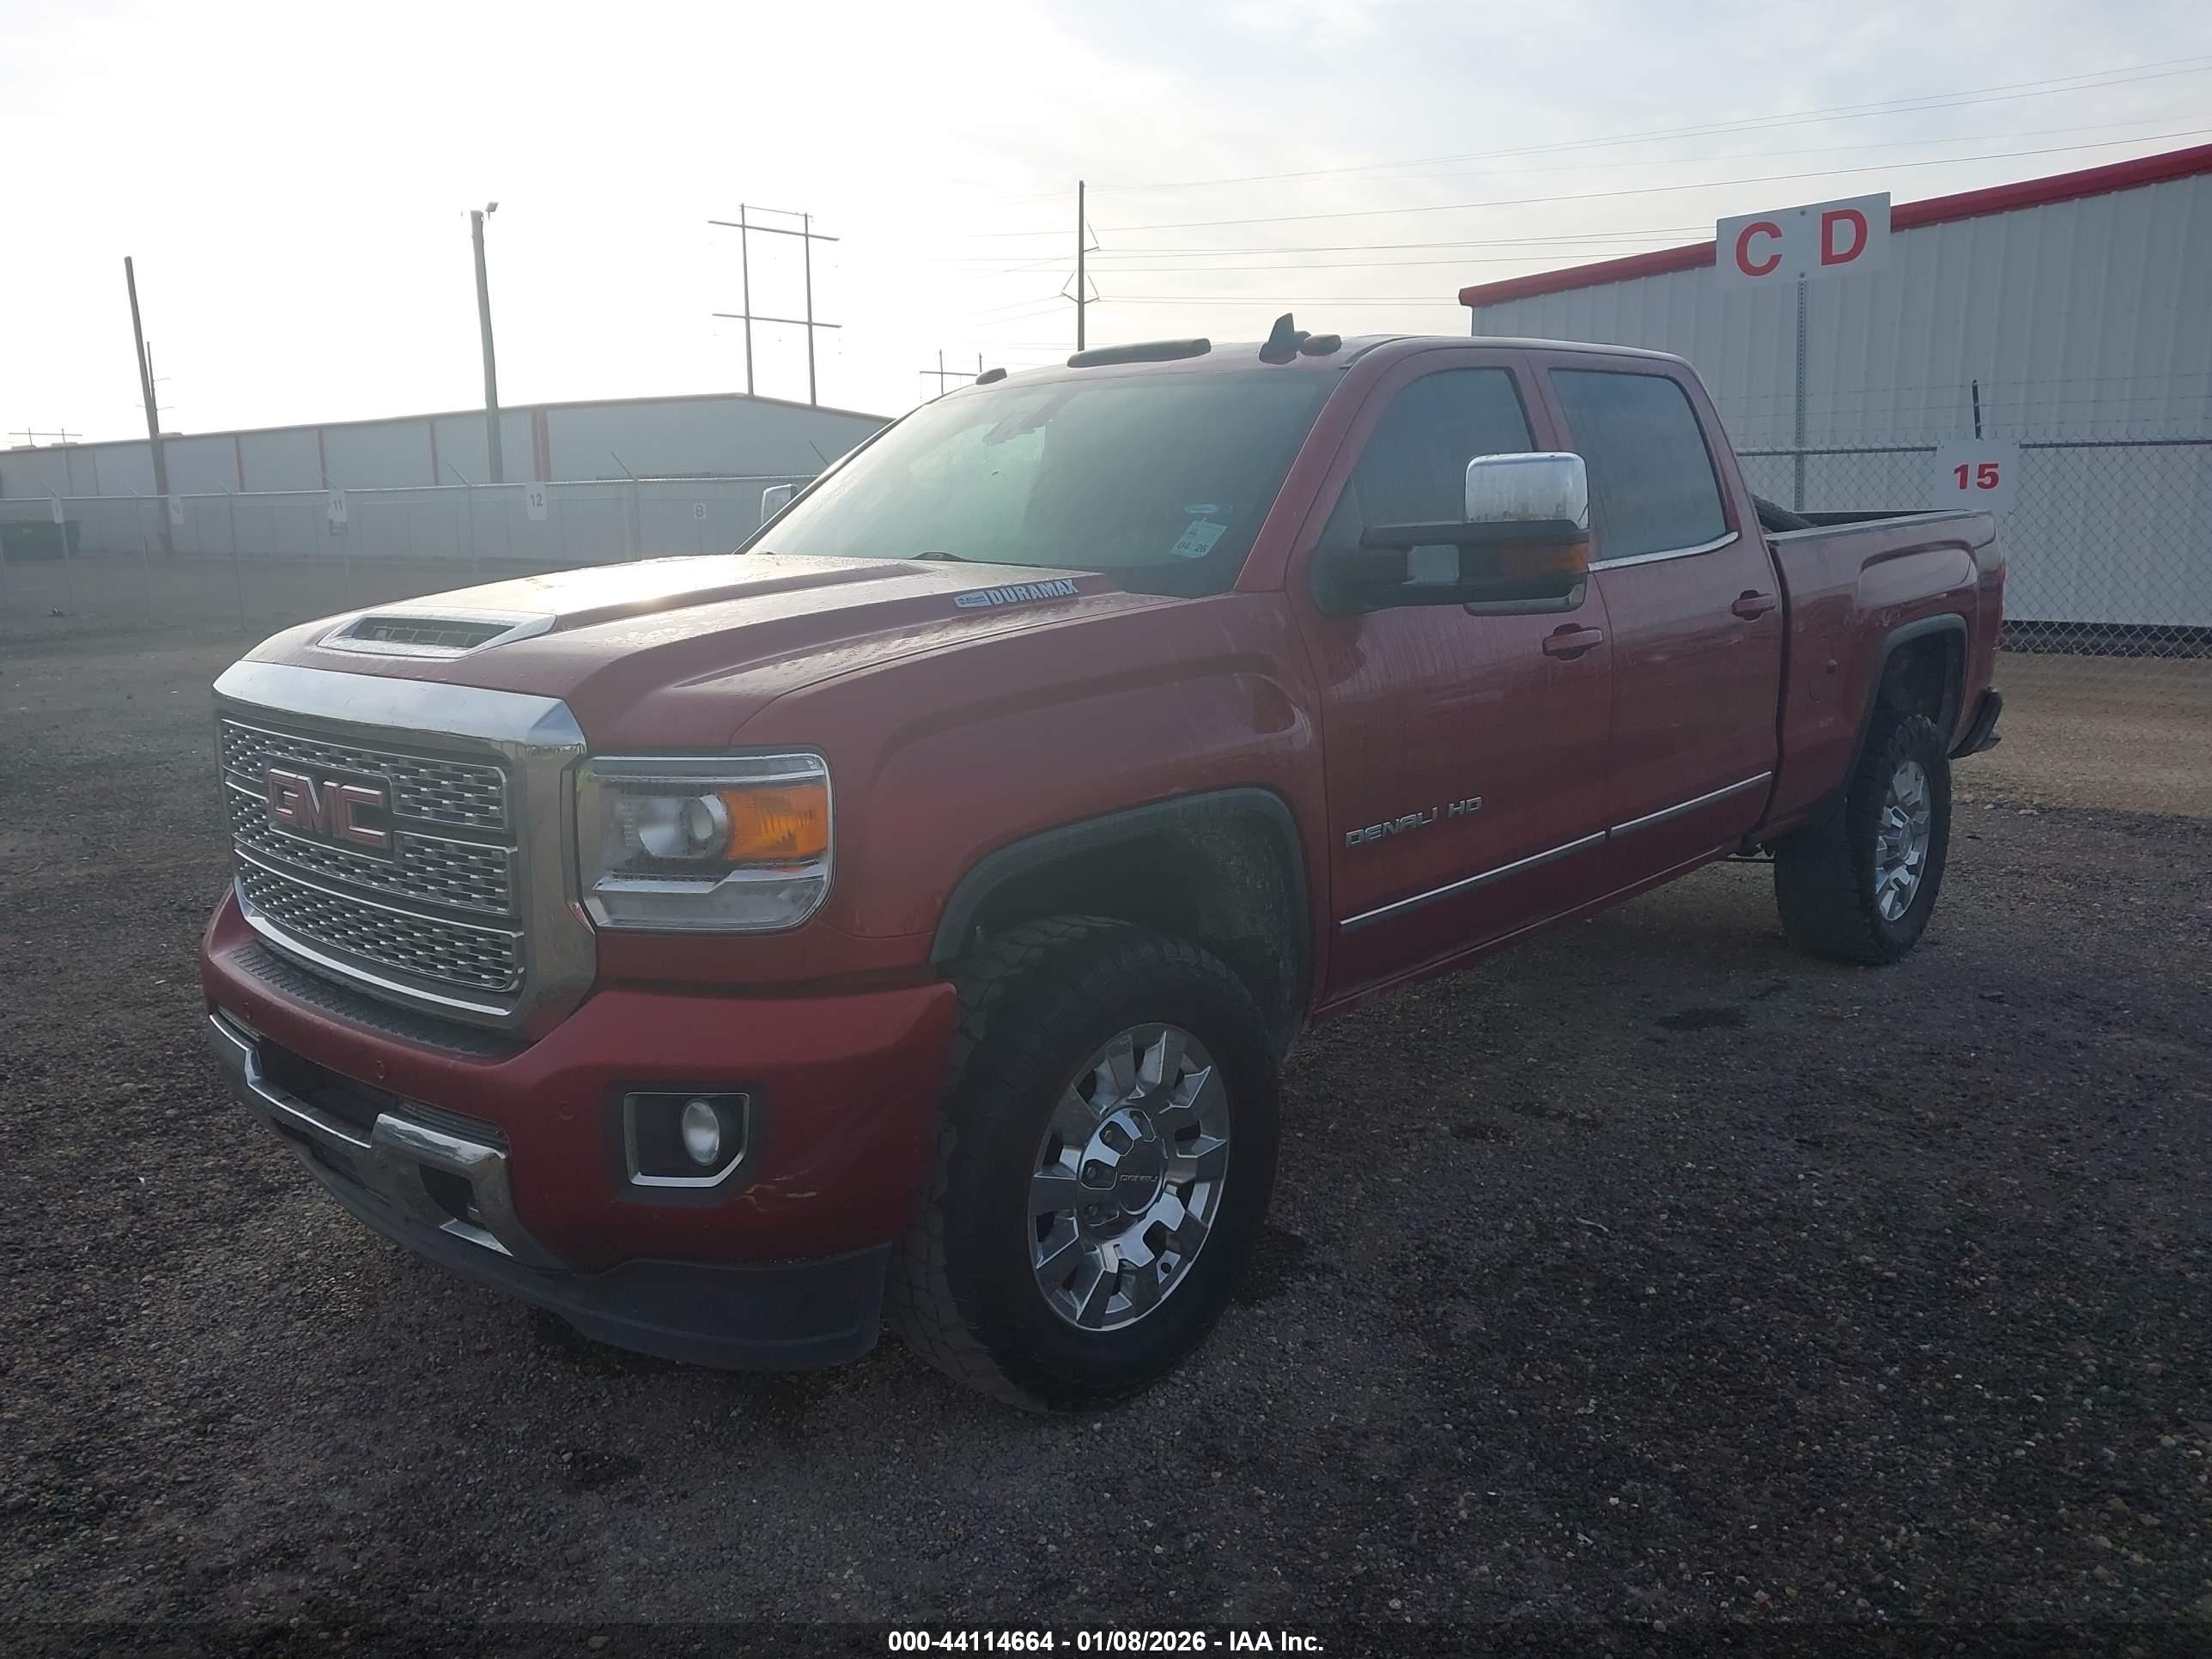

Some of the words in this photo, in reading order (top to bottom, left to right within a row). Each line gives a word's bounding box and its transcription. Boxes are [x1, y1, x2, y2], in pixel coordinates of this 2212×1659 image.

[1735, 222, 1783, 276] C
[1821, 209, 1869, 266] D
[1954, 463, 1999, 489] 15
[333, 499, 343, 511] 11
[530, 493, 544, 507] 12
[986, 579, 1079, 605] DURAMAX
[268, 768, 386, 847] GMC
[1346, 806, 1437, 848] DENALI
[1448, 796, 1483, 817] HD
